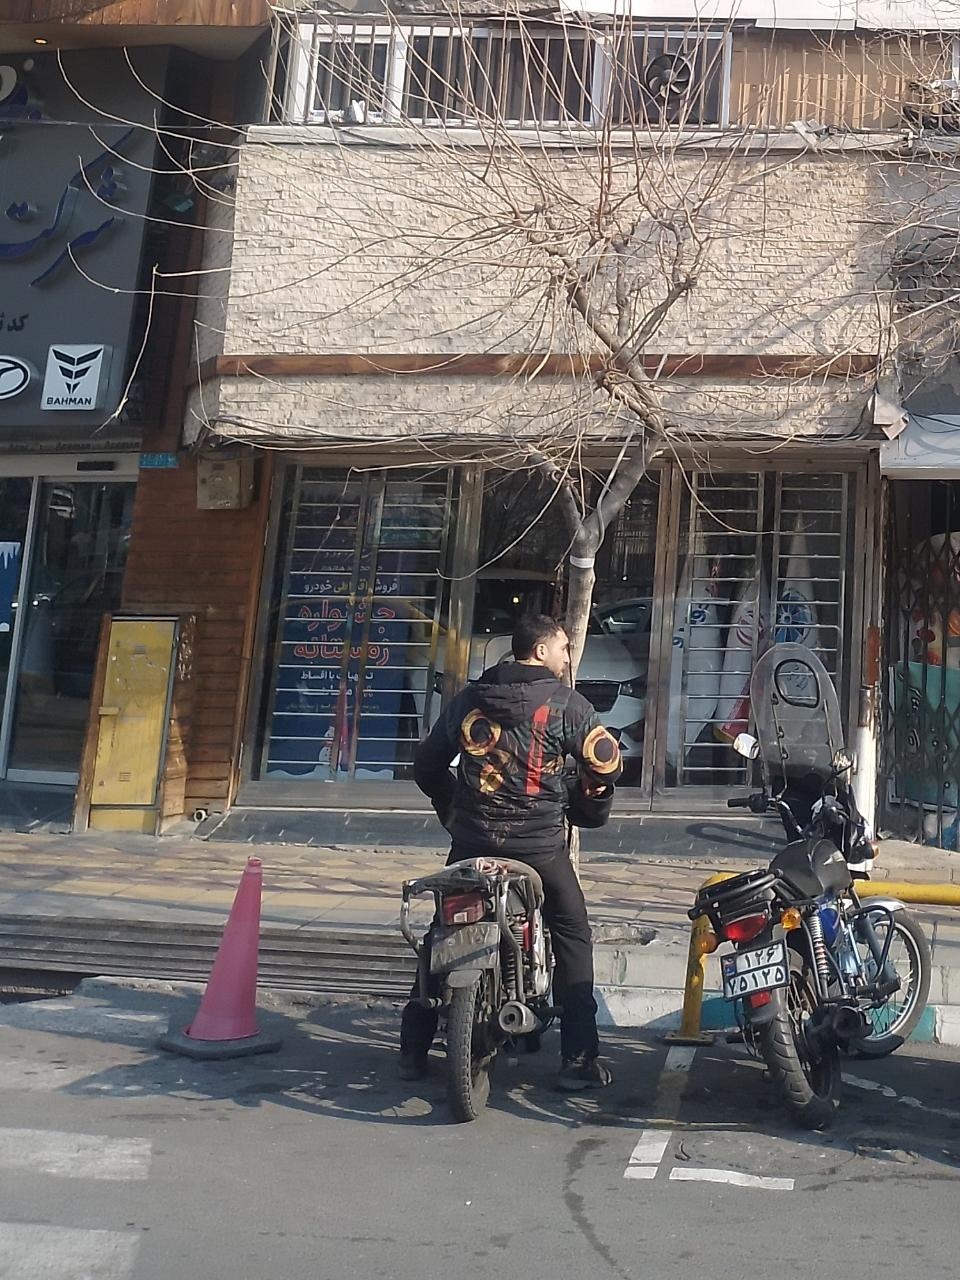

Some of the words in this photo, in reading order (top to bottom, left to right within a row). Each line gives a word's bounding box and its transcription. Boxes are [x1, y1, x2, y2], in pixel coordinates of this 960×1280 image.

[46, 397, 92, 405] BAHMAN
[303, 580, 333, 592] خودرو
[728, 966, 784, 995] ۷۵۱۲۵
